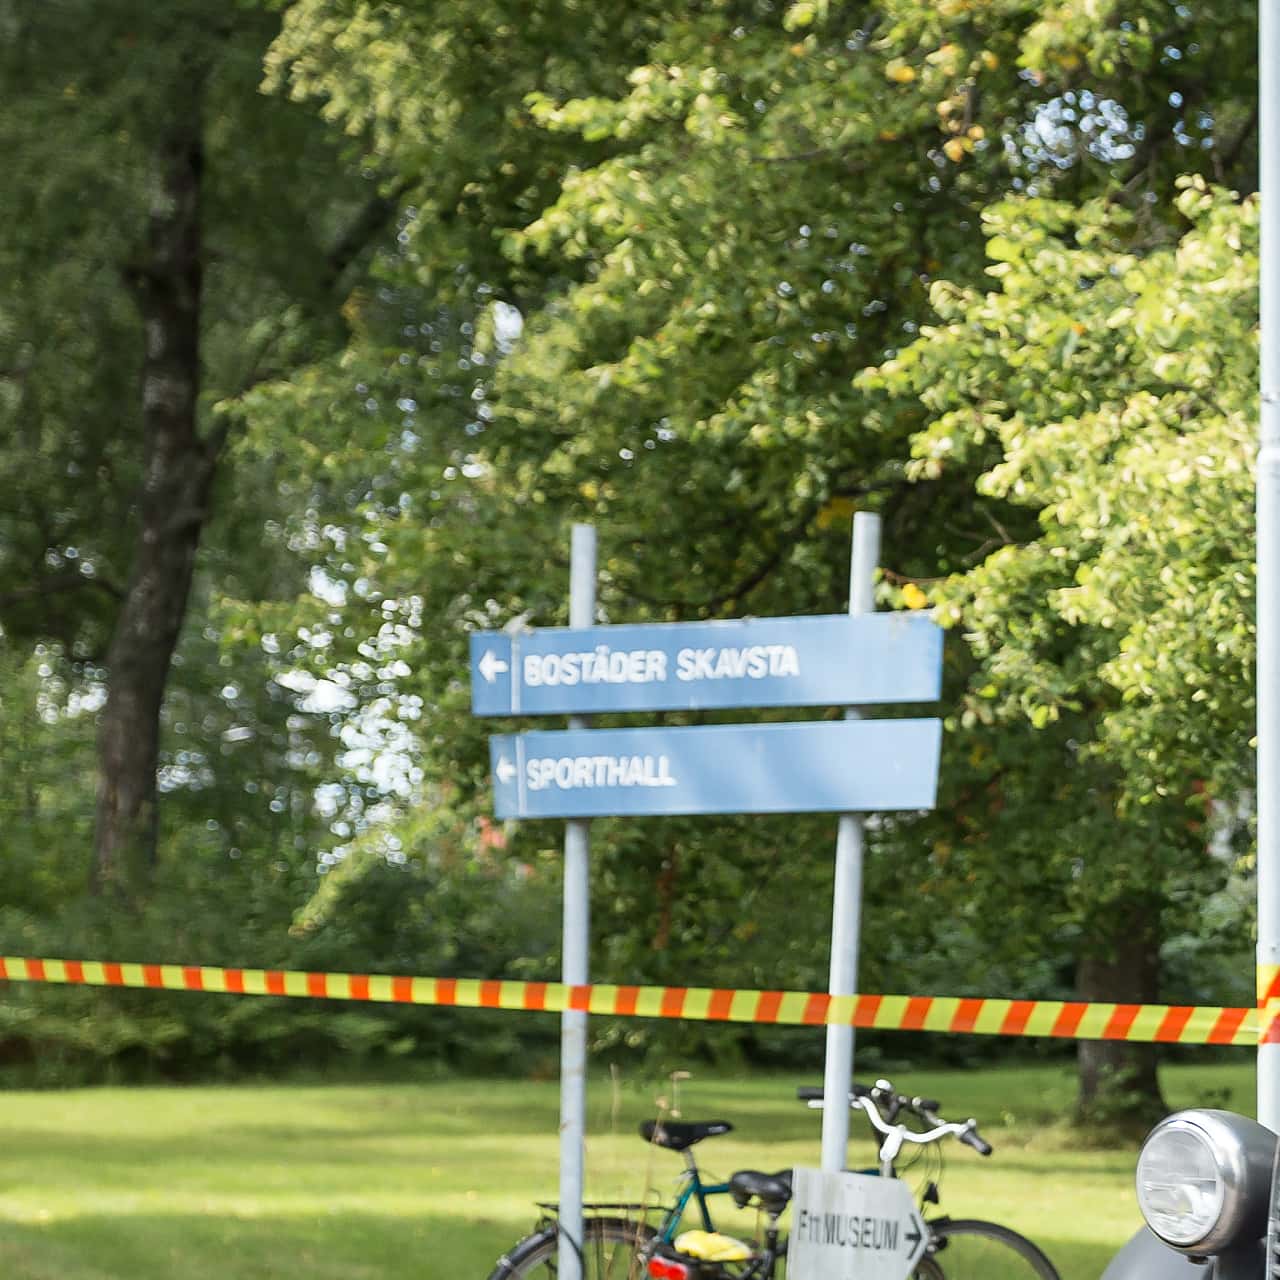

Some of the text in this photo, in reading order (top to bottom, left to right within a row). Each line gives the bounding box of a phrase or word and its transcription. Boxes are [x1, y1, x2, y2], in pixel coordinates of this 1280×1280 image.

[523, 645, 800, 686] BOSTÄDER SKAVSTA
[526, 755, 677, 790] SPORTHALL
[824, 1212, 898, 1251] MUSEUM
